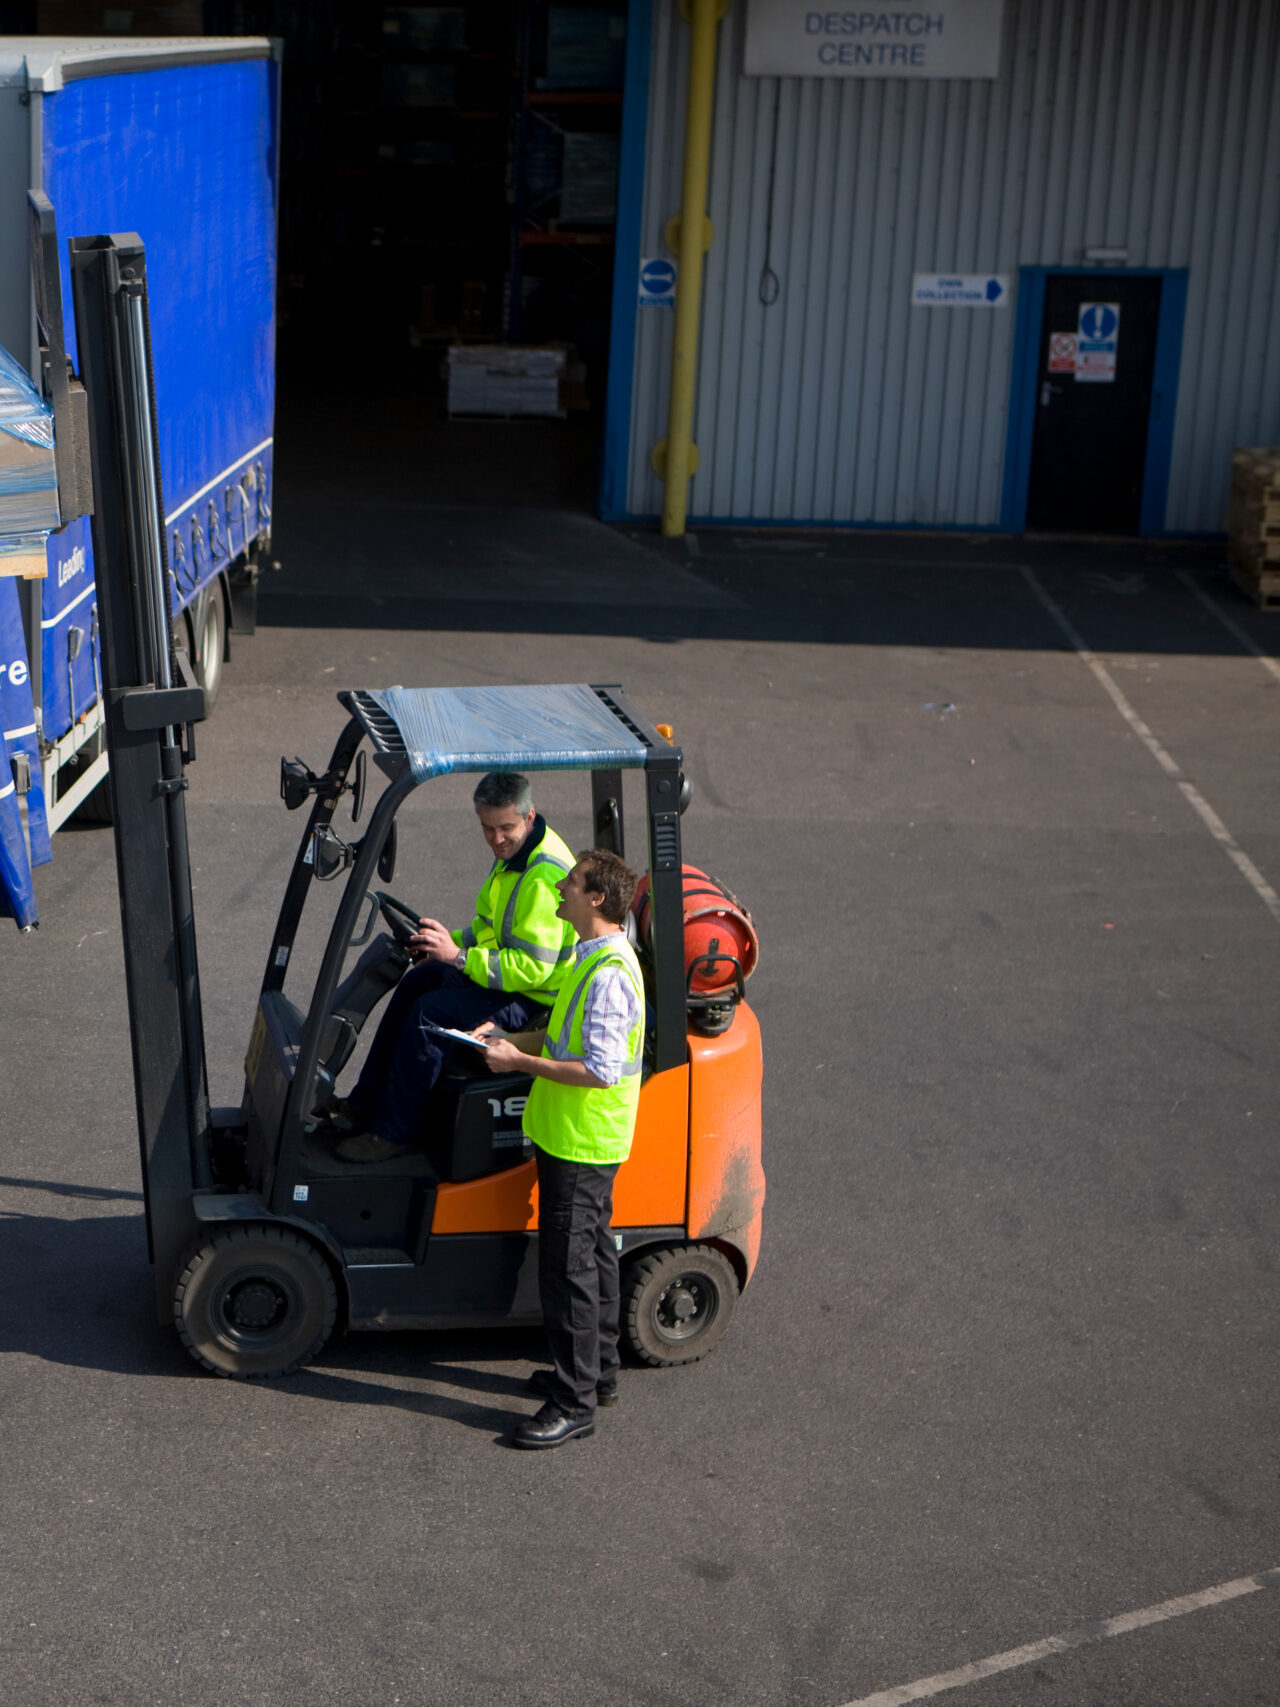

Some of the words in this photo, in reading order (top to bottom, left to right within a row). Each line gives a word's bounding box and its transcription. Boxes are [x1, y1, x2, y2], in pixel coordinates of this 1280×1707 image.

[804, 11, 944, 36] DESPATCH
[817, 42, 927, 66] CENTRE
[487, 1096, 529, 1118] 18
